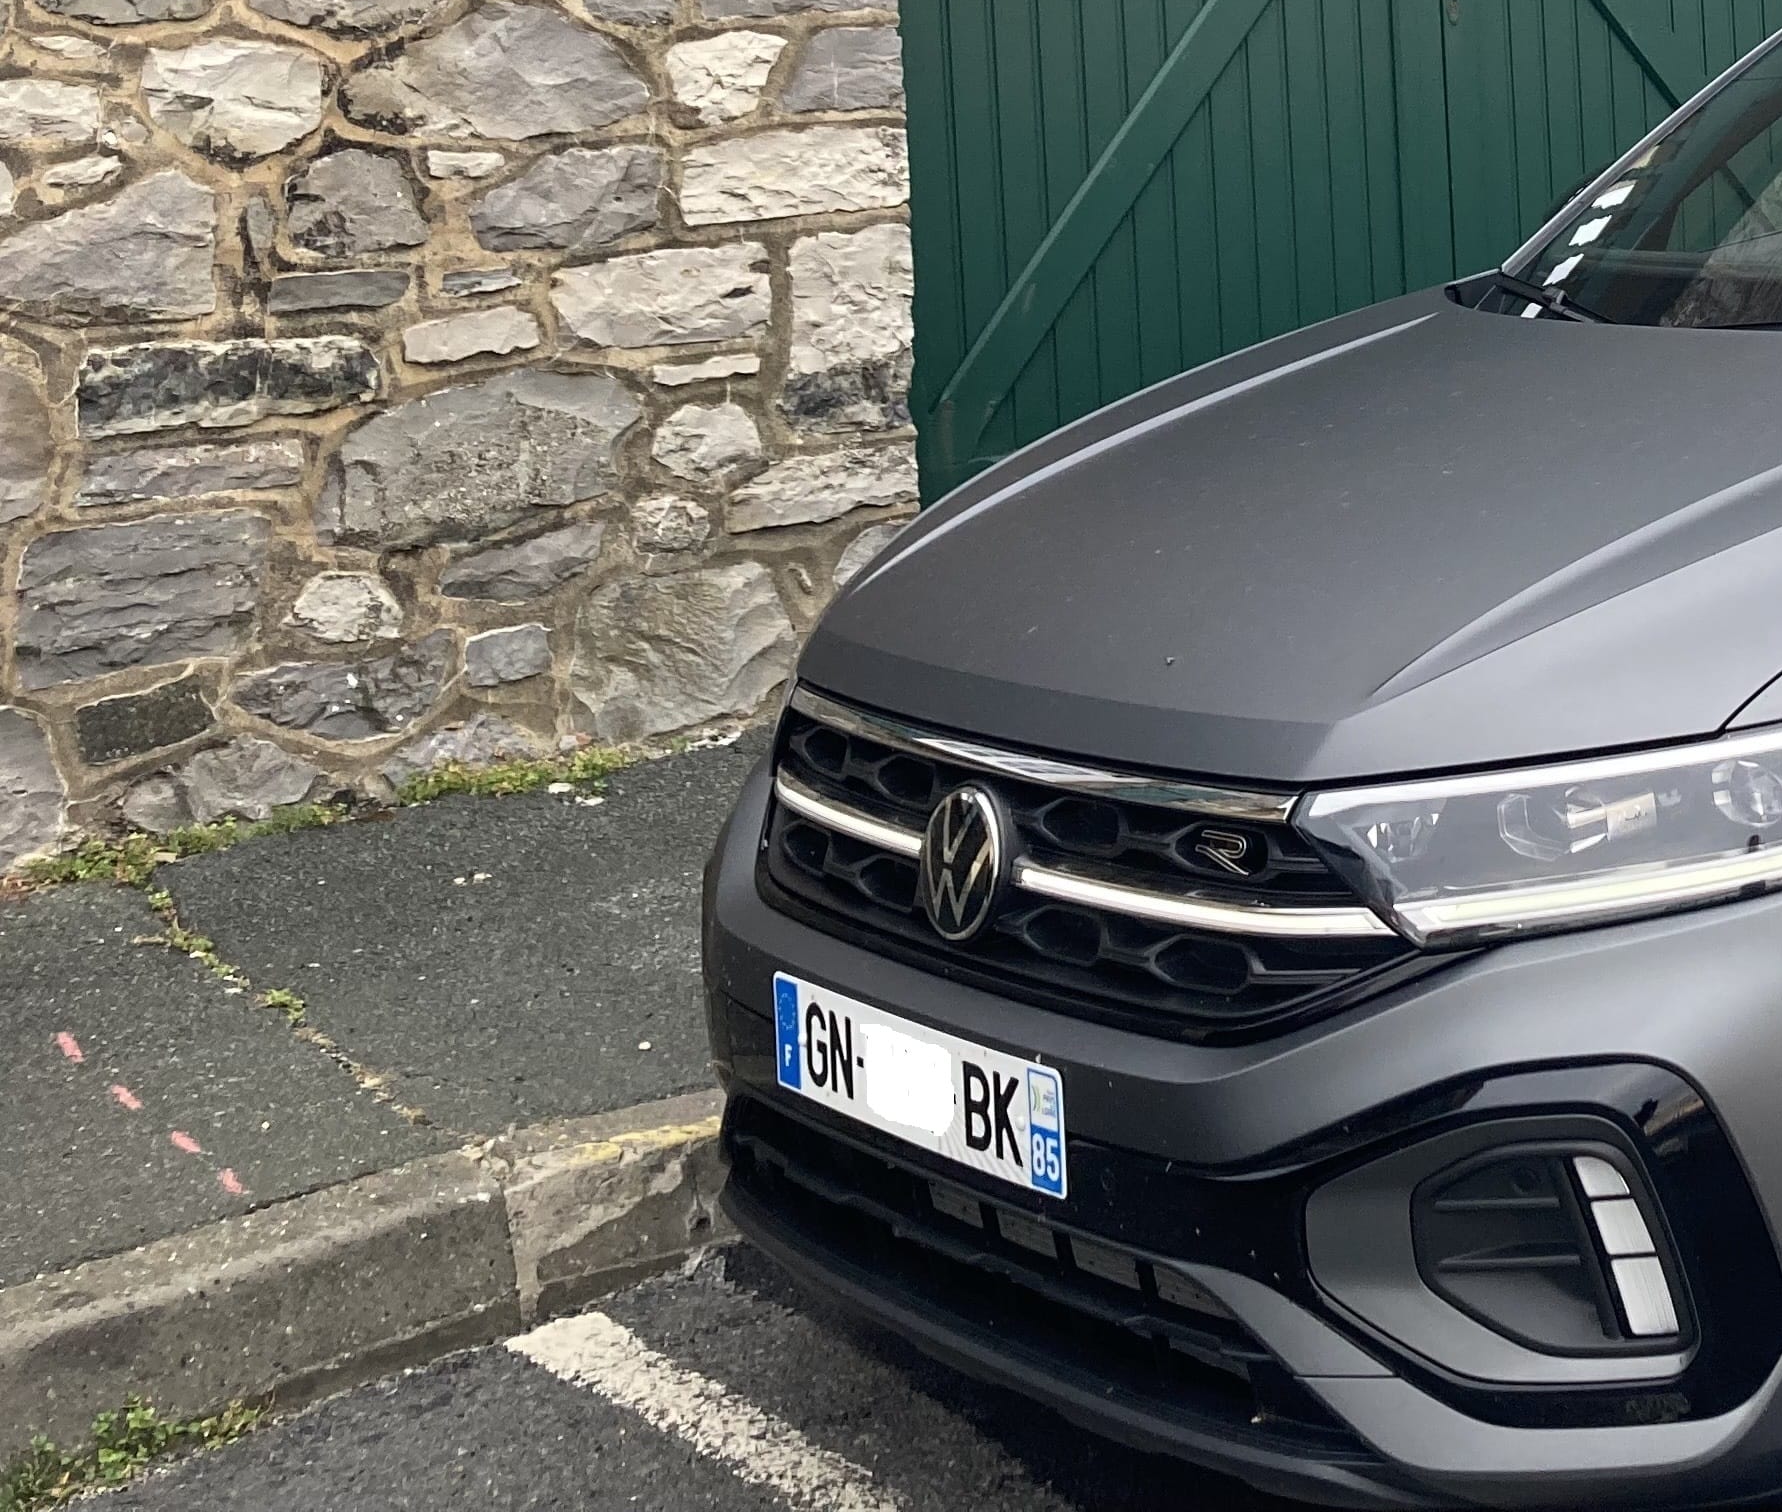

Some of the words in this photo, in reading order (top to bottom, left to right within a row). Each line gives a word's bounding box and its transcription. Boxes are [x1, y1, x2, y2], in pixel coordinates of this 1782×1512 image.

[1195, 829, 1250, 876] R
[784, 1044, 792, 1067] F
[1031, 1133, 1059, 1182] 85
